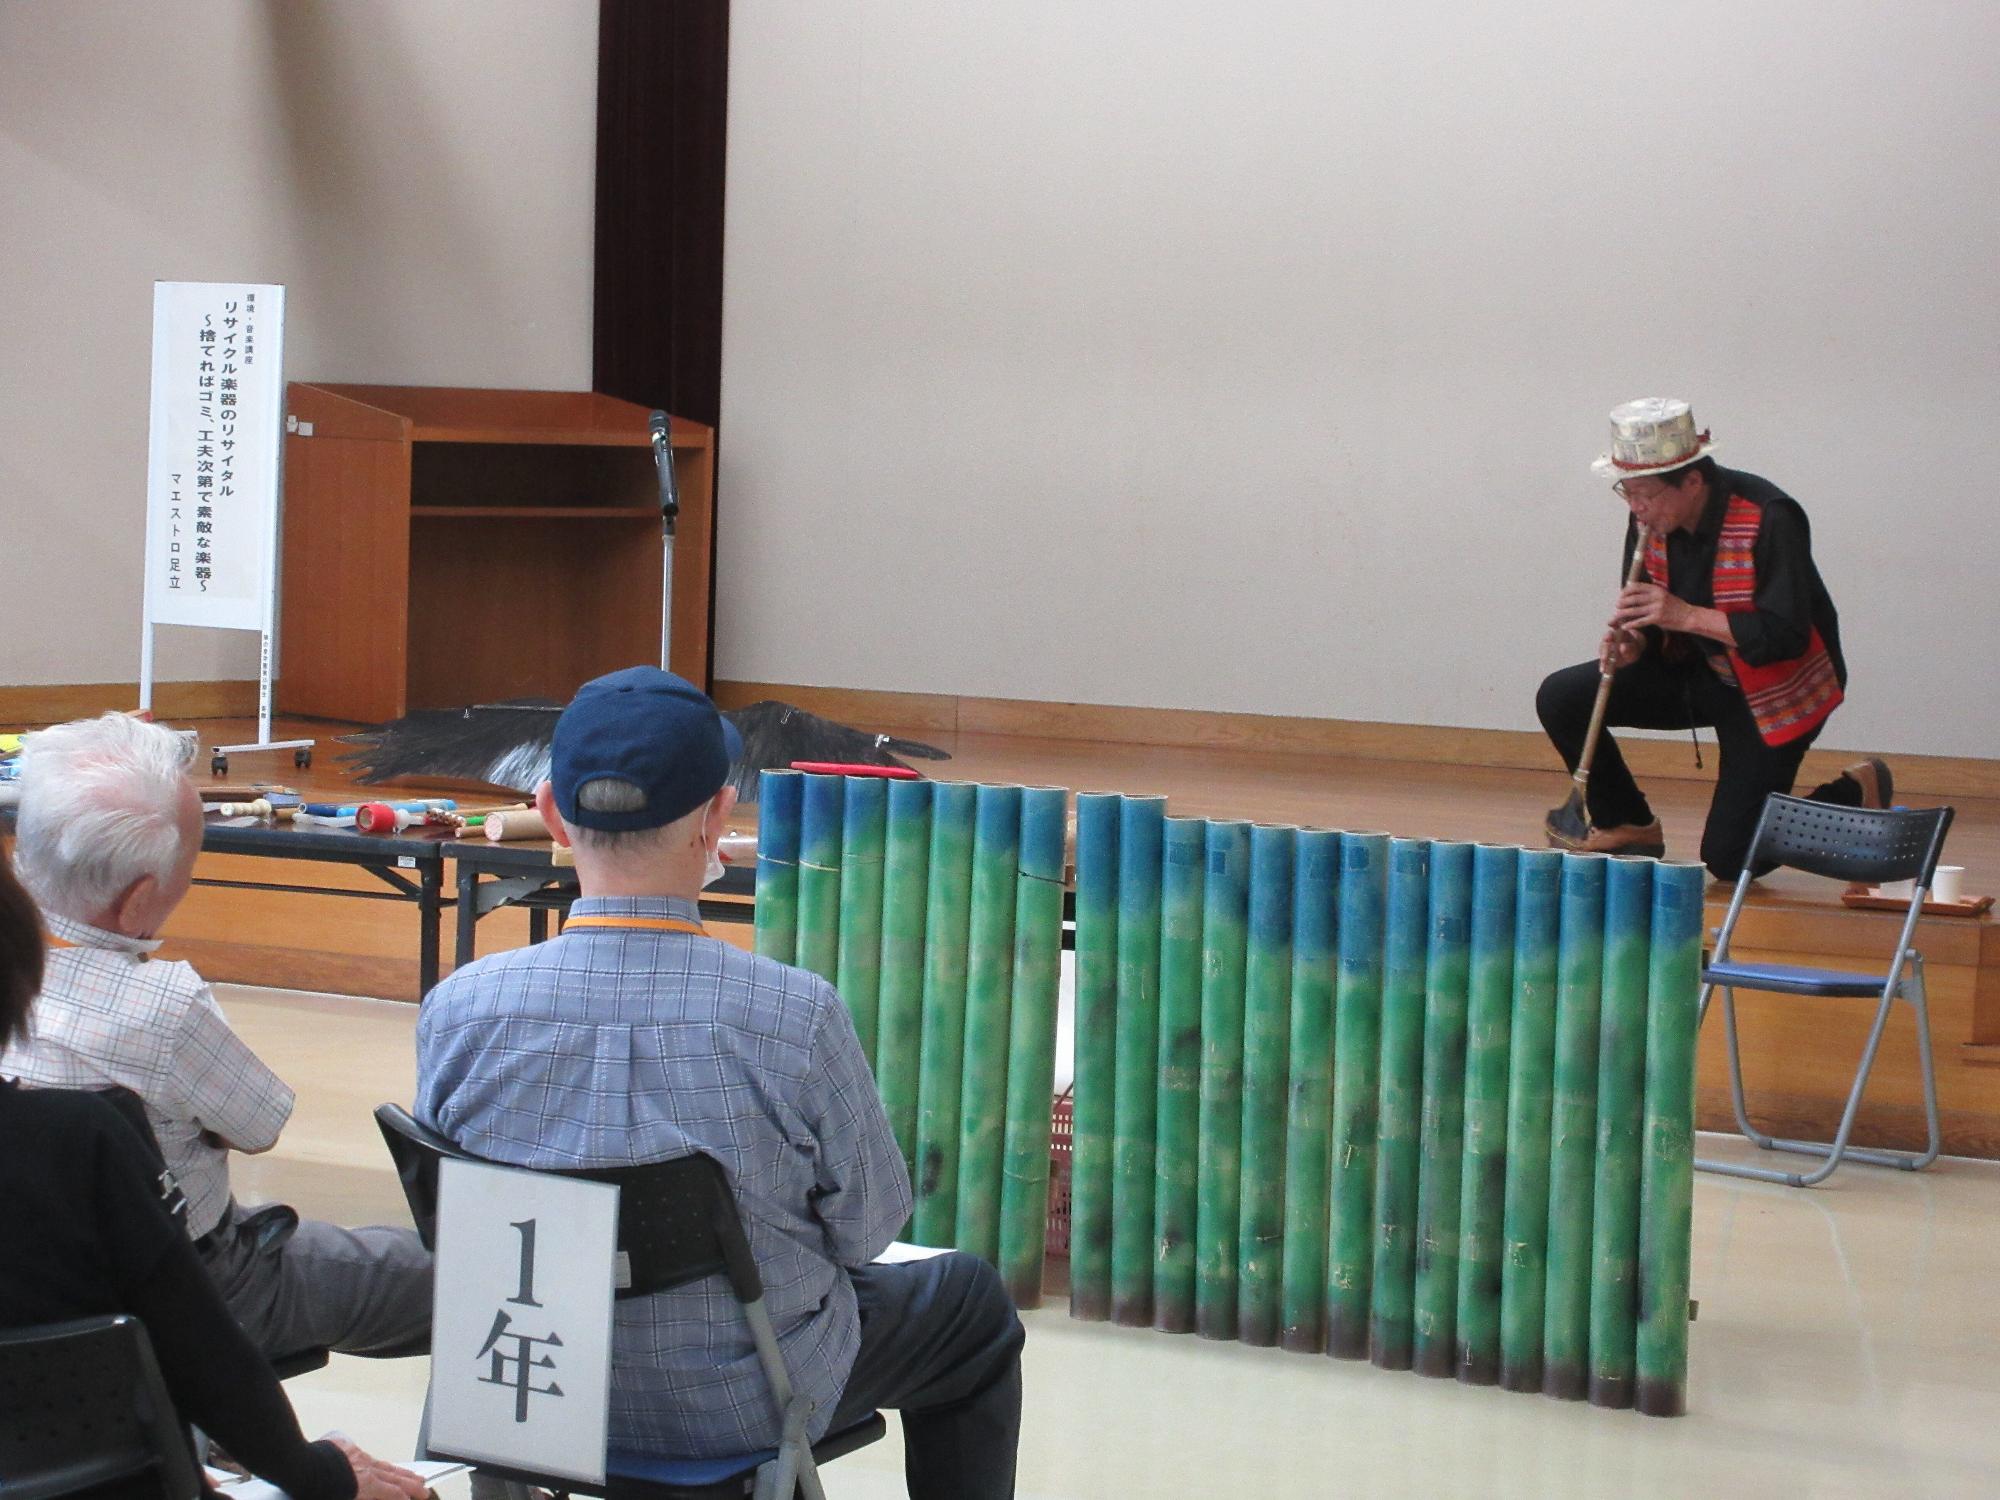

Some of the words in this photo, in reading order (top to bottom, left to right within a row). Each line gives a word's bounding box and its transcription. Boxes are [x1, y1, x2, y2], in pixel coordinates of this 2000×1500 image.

[219, 301, 238, 497] リサイクル楽器のリサイタル
[244, 293, 255, 365] 環境・音楽講座
[169, 473, 182, 589] マエストロ足立
[476, 1218, 565, 1423] 1年
